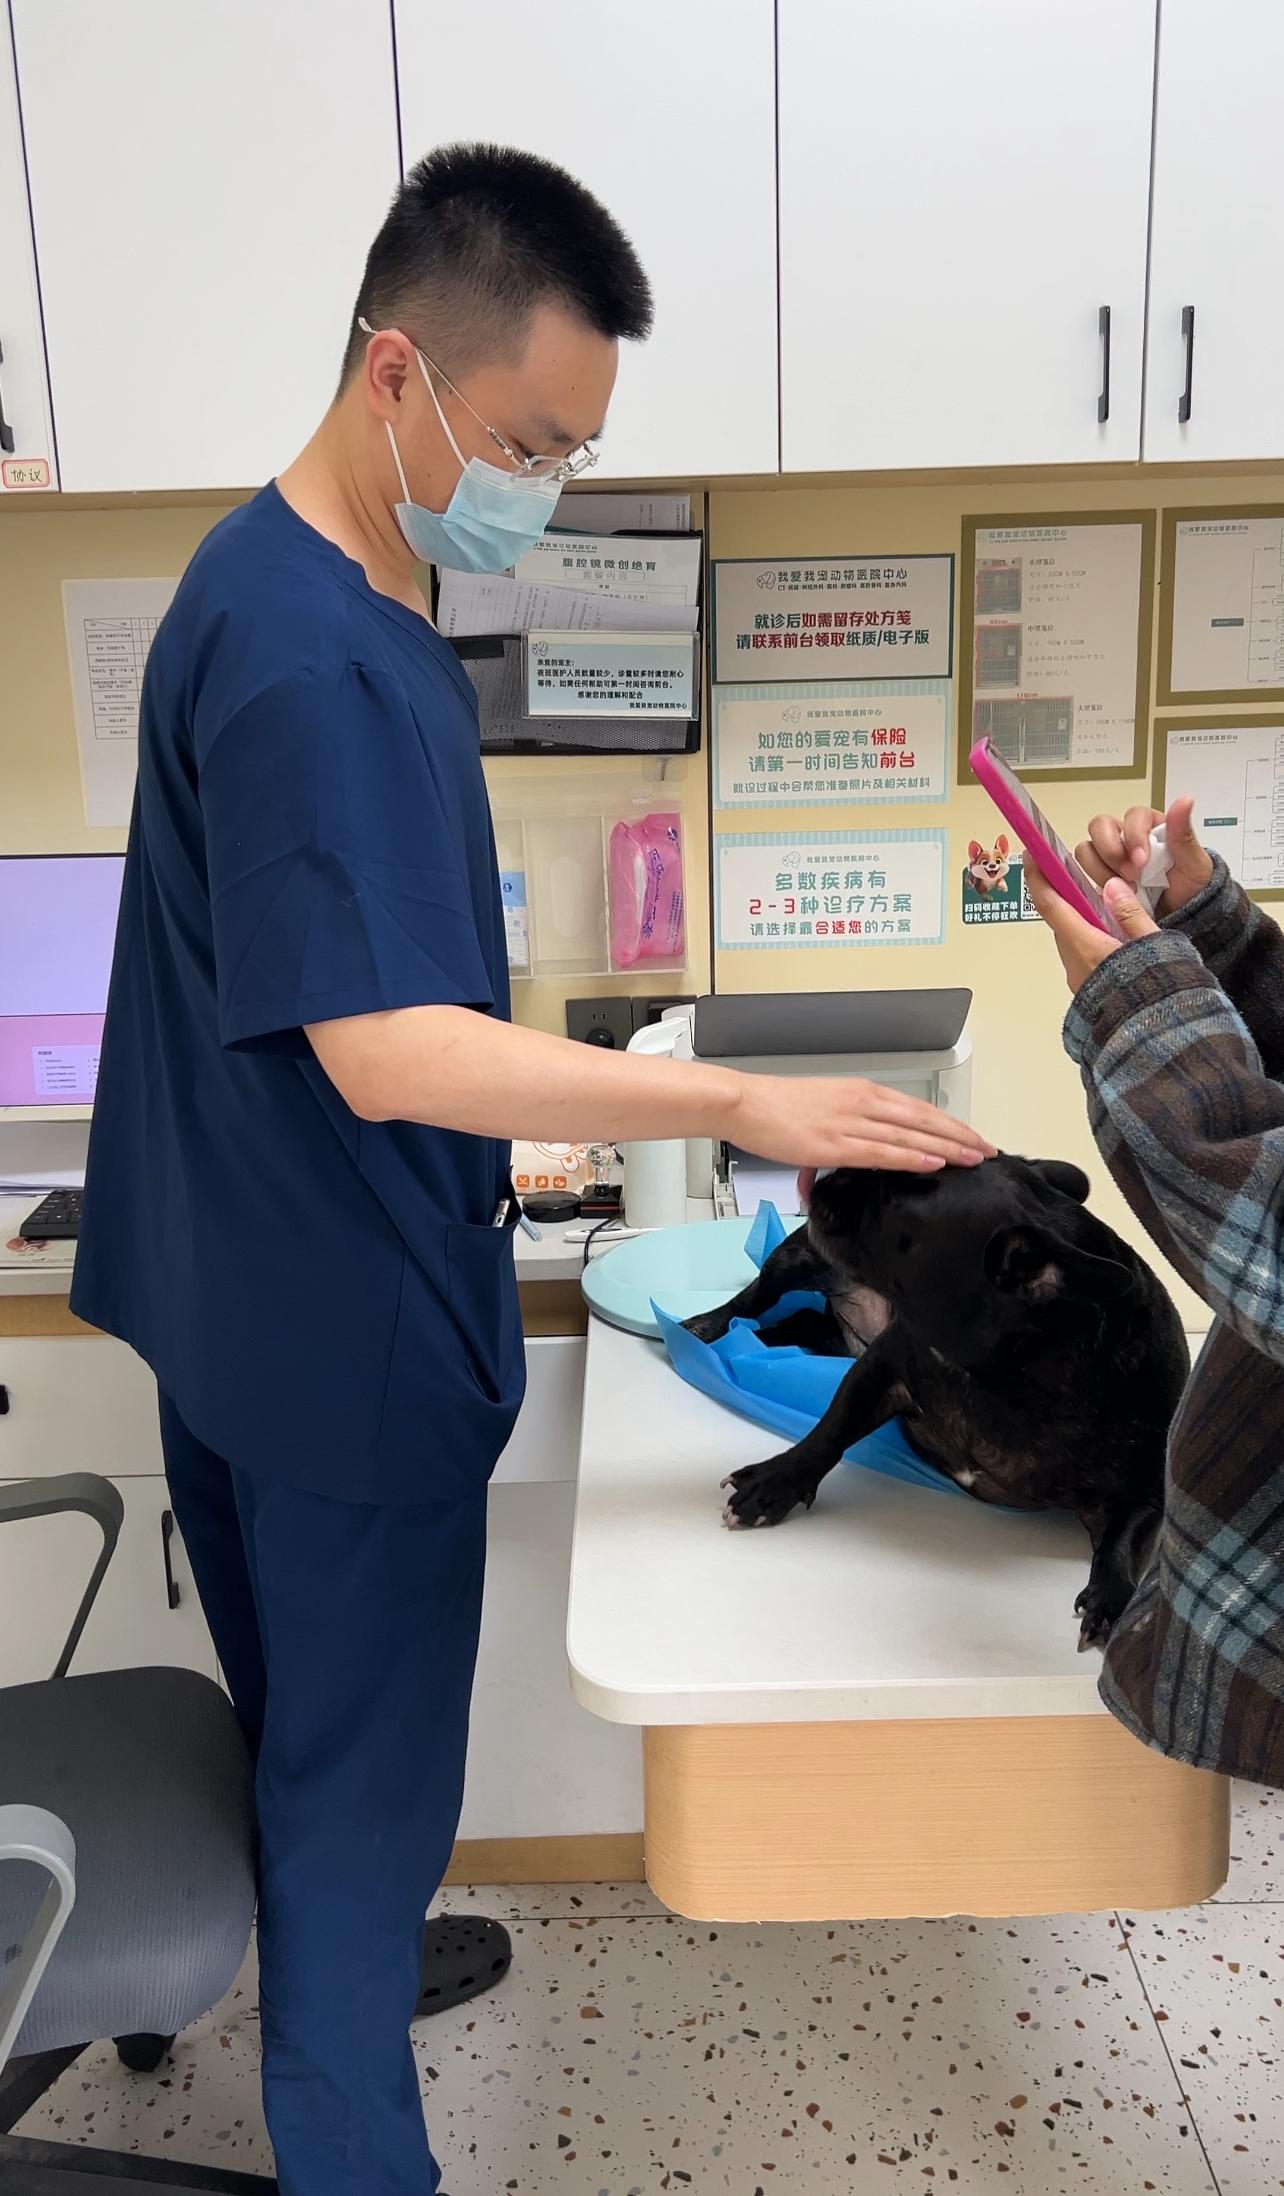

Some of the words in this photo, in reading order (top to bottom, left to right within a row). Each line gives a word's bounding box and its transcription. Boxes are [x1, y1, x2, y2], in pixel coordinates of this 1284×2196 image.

[11, 468, 42, 483] 协议
[562, 557, 657, 571] 腹腔镜微创绝育
[777, 568, 907, 582] 我爱我宠动物医院中心
[754, 610, 912, 630] 就诊后如需留存处方笺
[736, 629, 930, 650] 请联系前台领取纸质/电子版
[577, 691, 643, 700] 感谢您的理解和配合
[758, 727, 907, 750] 如您的爱宠有保险
[748, 750, 916, 773] 请第一时间告知前台
[733, 776, 930, 794] 就诊过程中会帮您准备照片及相关材料
[775, 870, 887, 892] 多数疾病有
[750, 919, 912, 937] 请选择最合适您的方案
